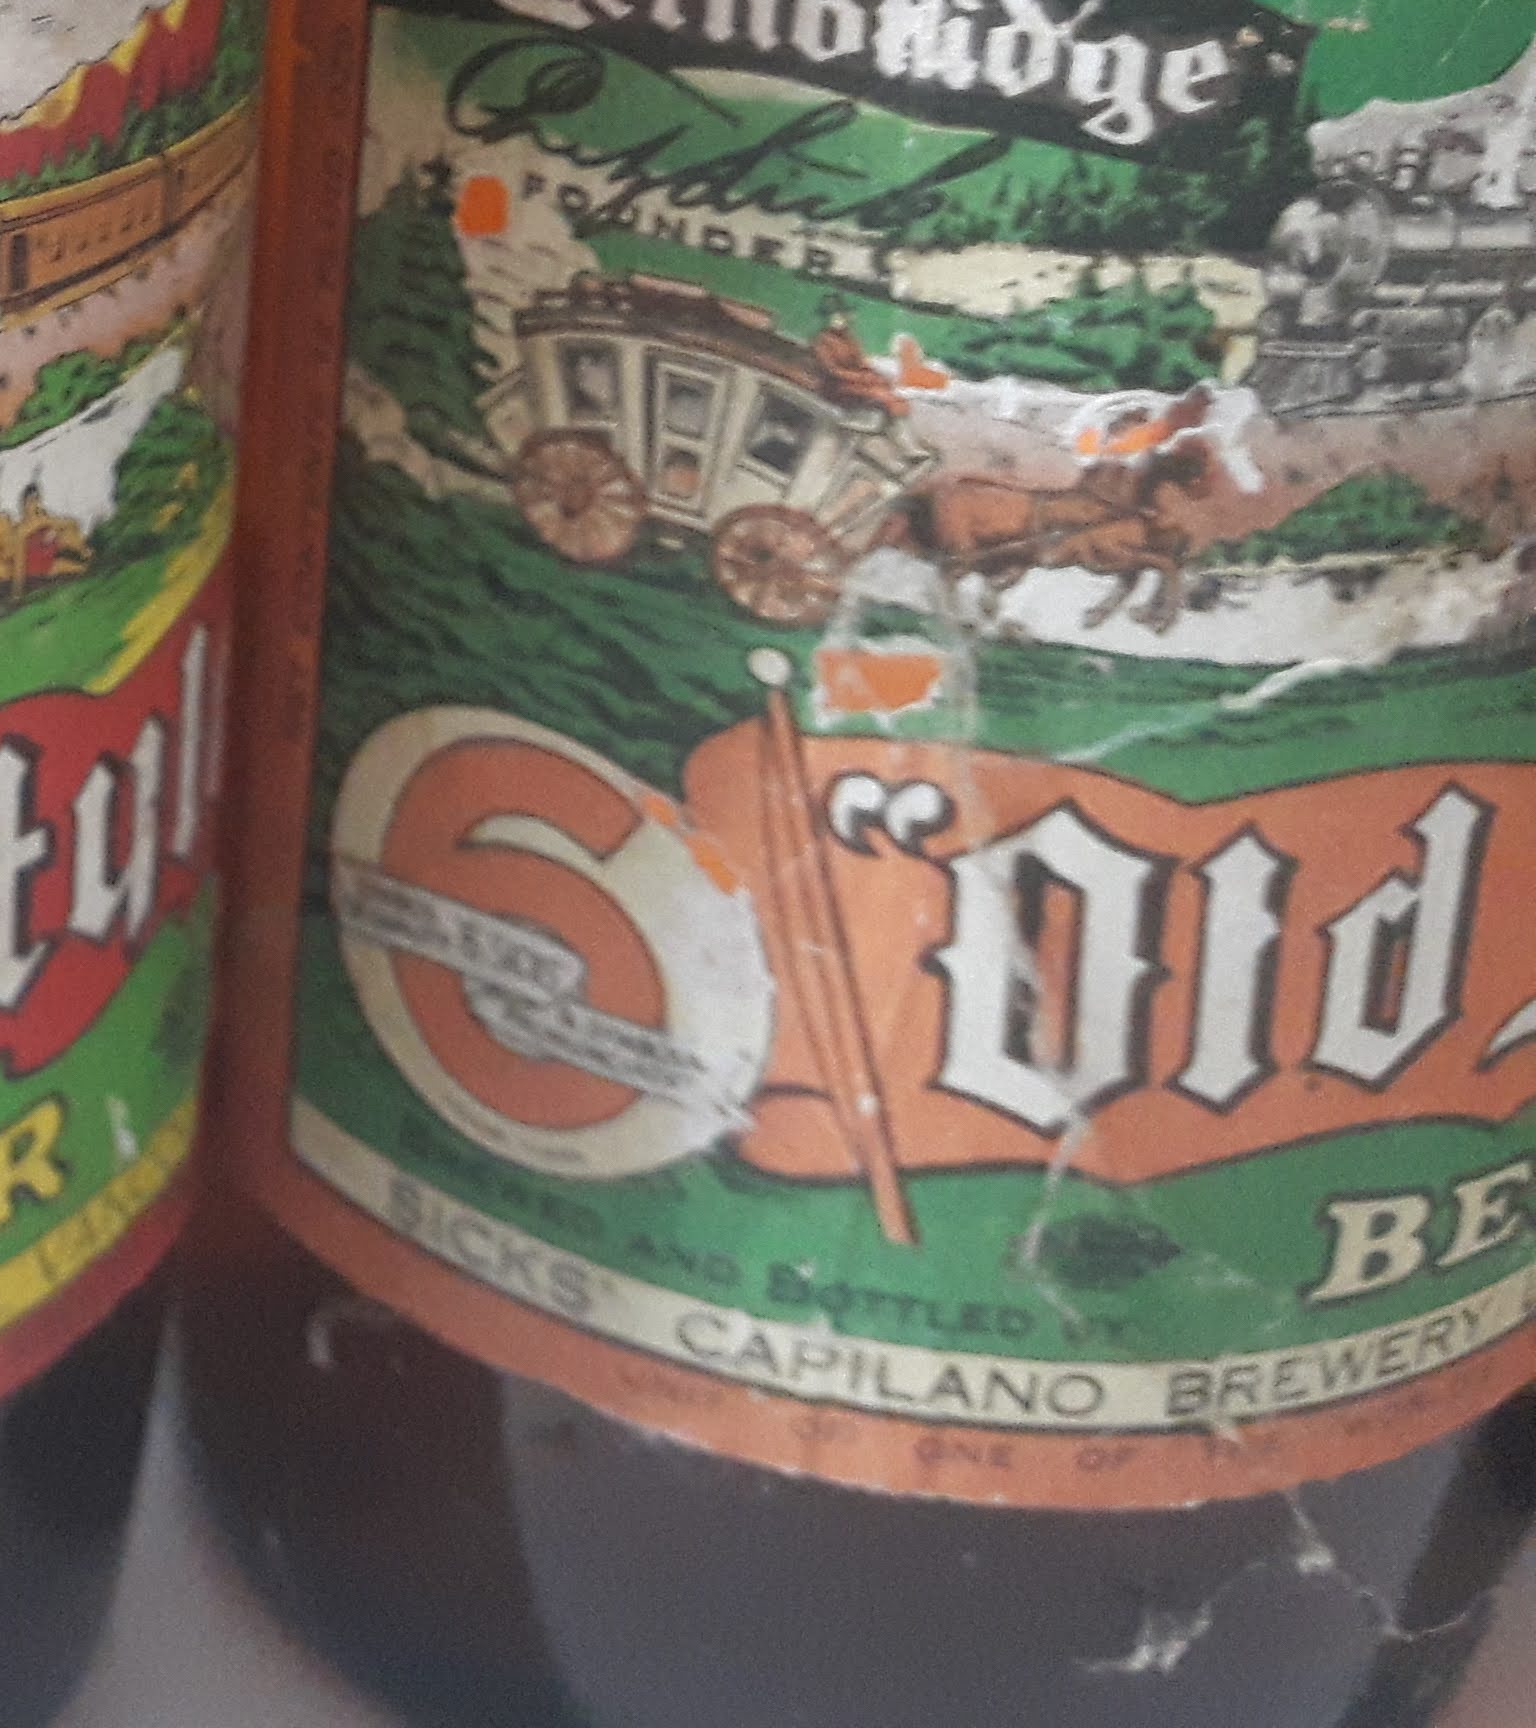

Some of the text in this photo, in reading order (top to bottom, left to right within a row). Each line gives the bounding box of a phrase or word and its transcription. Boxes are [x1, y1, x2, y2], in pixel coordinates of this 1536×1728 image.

[766, 1261, 1036, 1338] BOTTLED
[674, 1308, 1108, 1417] CAPILANO
[1166, 1295, 1494, 1418] BREWERY
